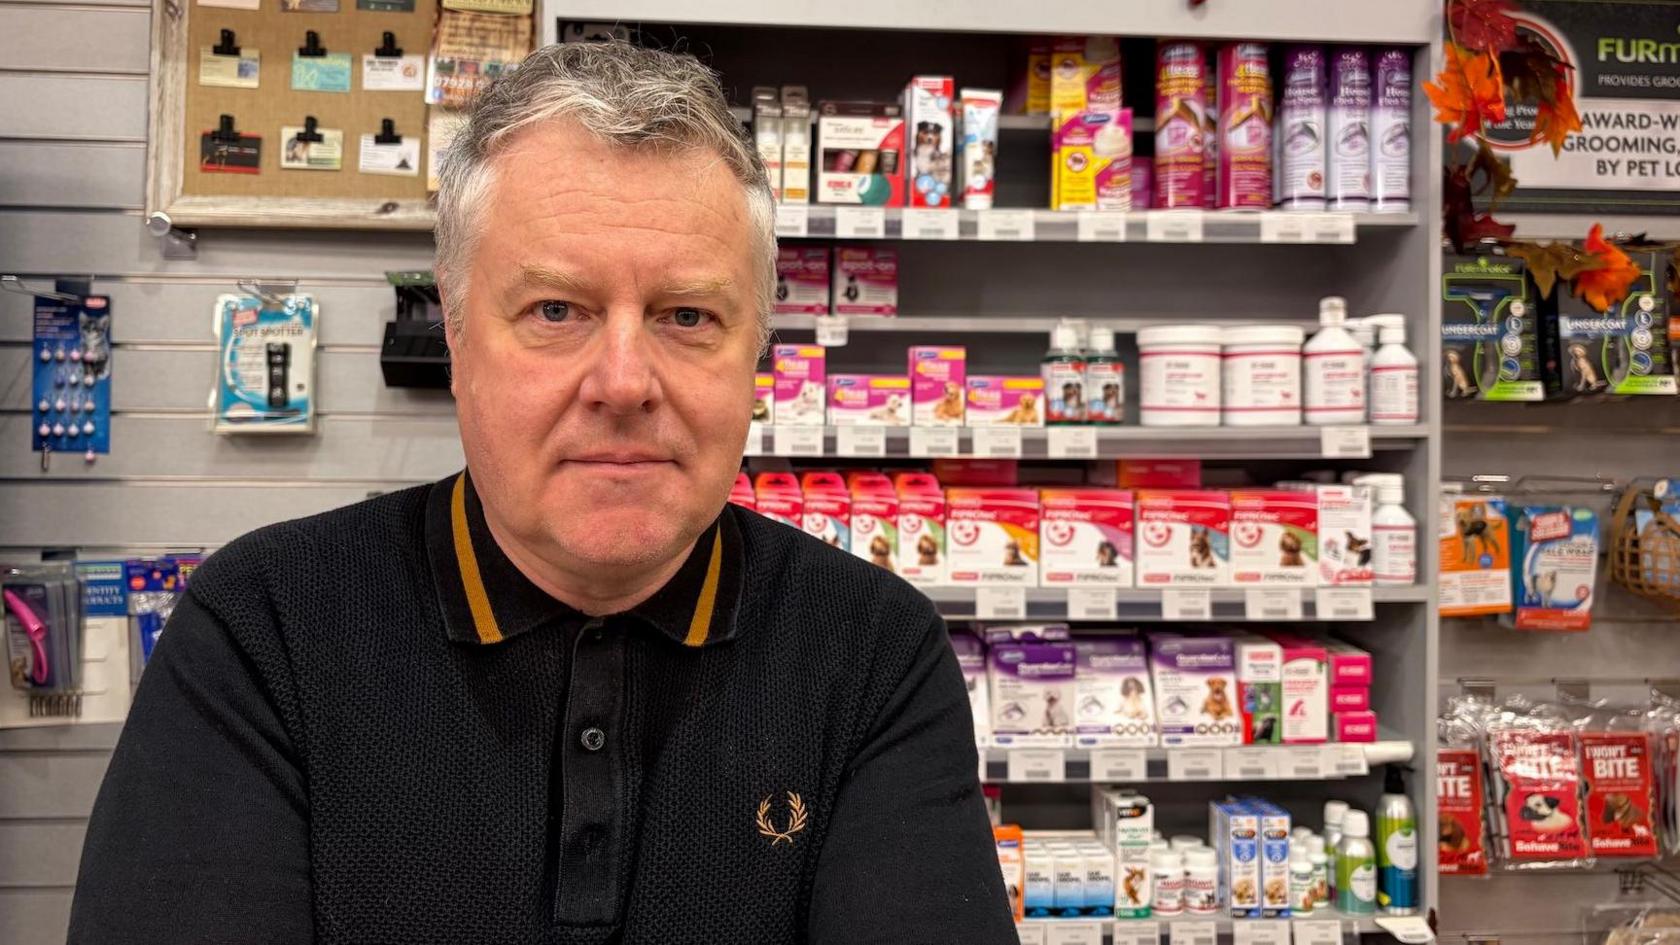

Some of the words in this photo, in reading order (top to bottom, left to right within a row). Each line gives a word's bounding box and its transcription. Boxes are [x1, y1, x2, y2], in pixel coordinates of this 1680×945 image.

[1598, 74, 1651, 87] PROVIDES
[1597, 160, 1619, 176] BY
[1627, 160, 1659, 176] PET
[1441, 324, 1498, 336] UNDERCOAT
[1567, 319, 1627, 332] UNDERCOAT
[1593, 757, 1640, 779] BITE
[1437, 776, 1472, 797] ITE
